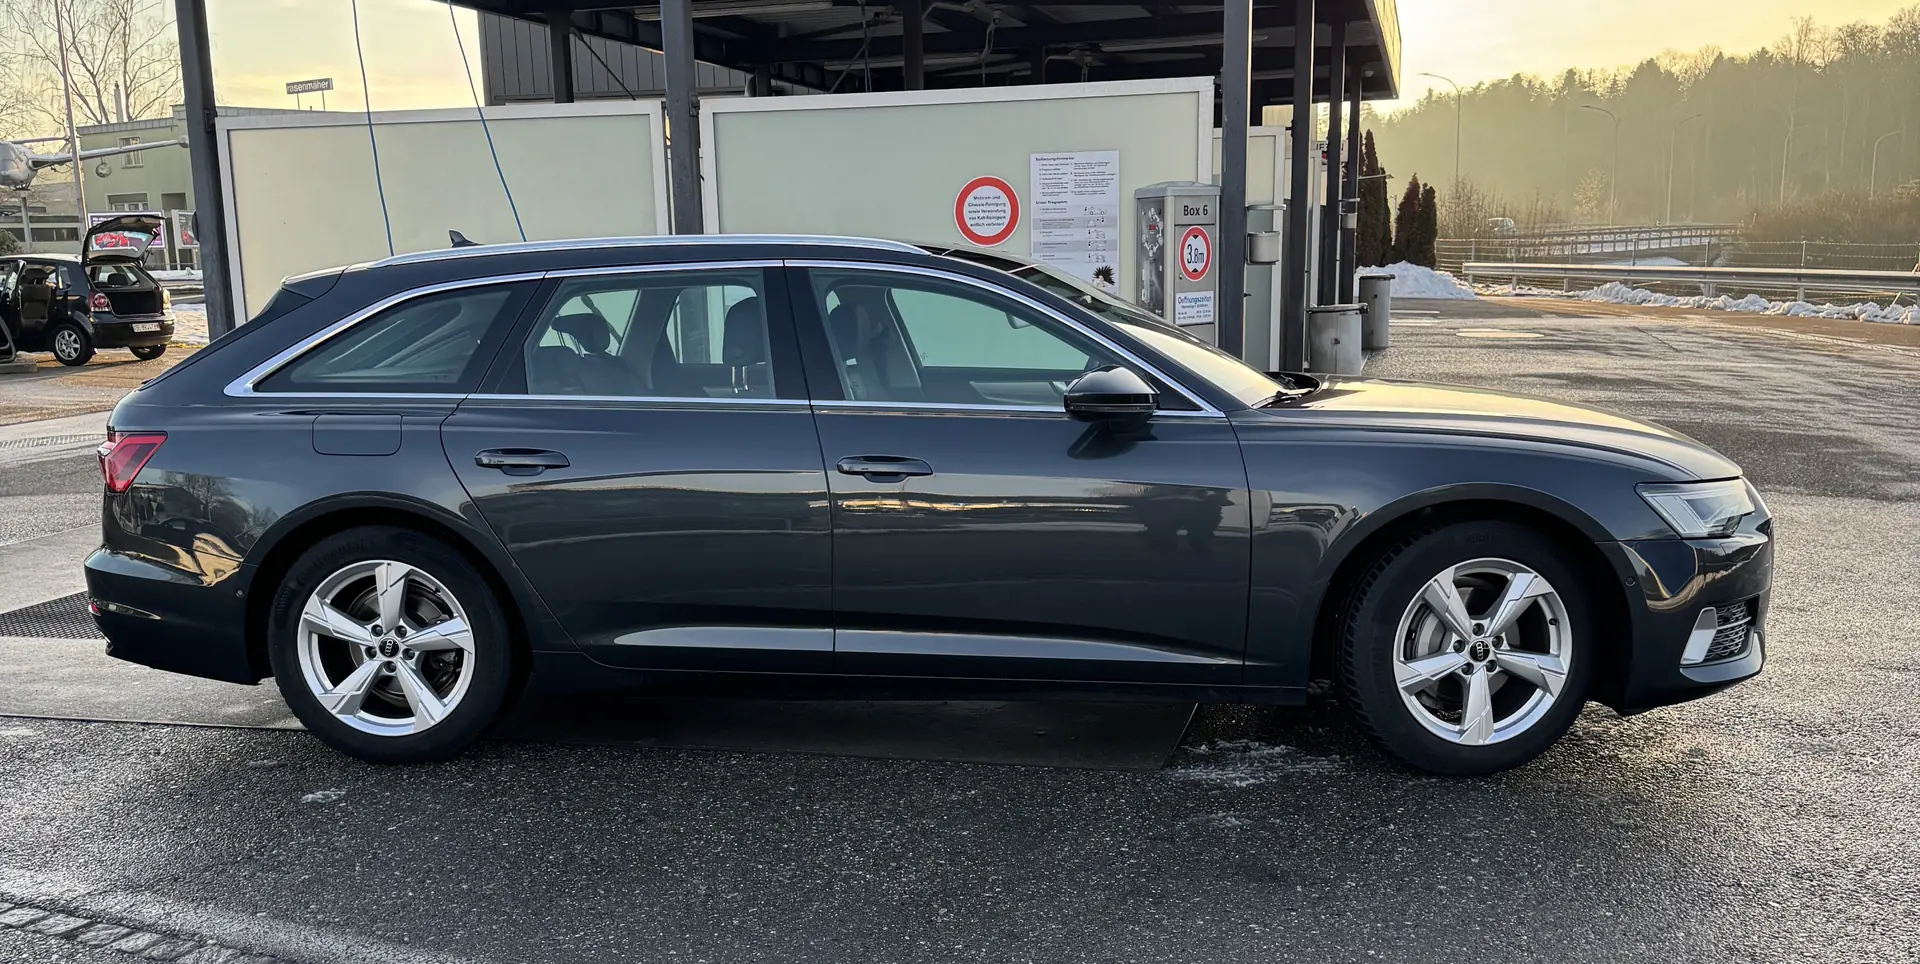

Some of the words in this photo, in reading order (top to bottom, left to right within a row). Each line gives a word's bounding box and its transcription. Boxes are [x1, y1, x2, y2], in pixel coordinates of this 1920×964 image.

[287, 80, 329, 92] rasenmäher
[1183, 205, 1200, 216] Box
[1202, 204, 1209, 216] 6
[1186, 243, 1205, 264] 3.8m
[1177, 295, 1212, 305] Oeffnungszeiten
